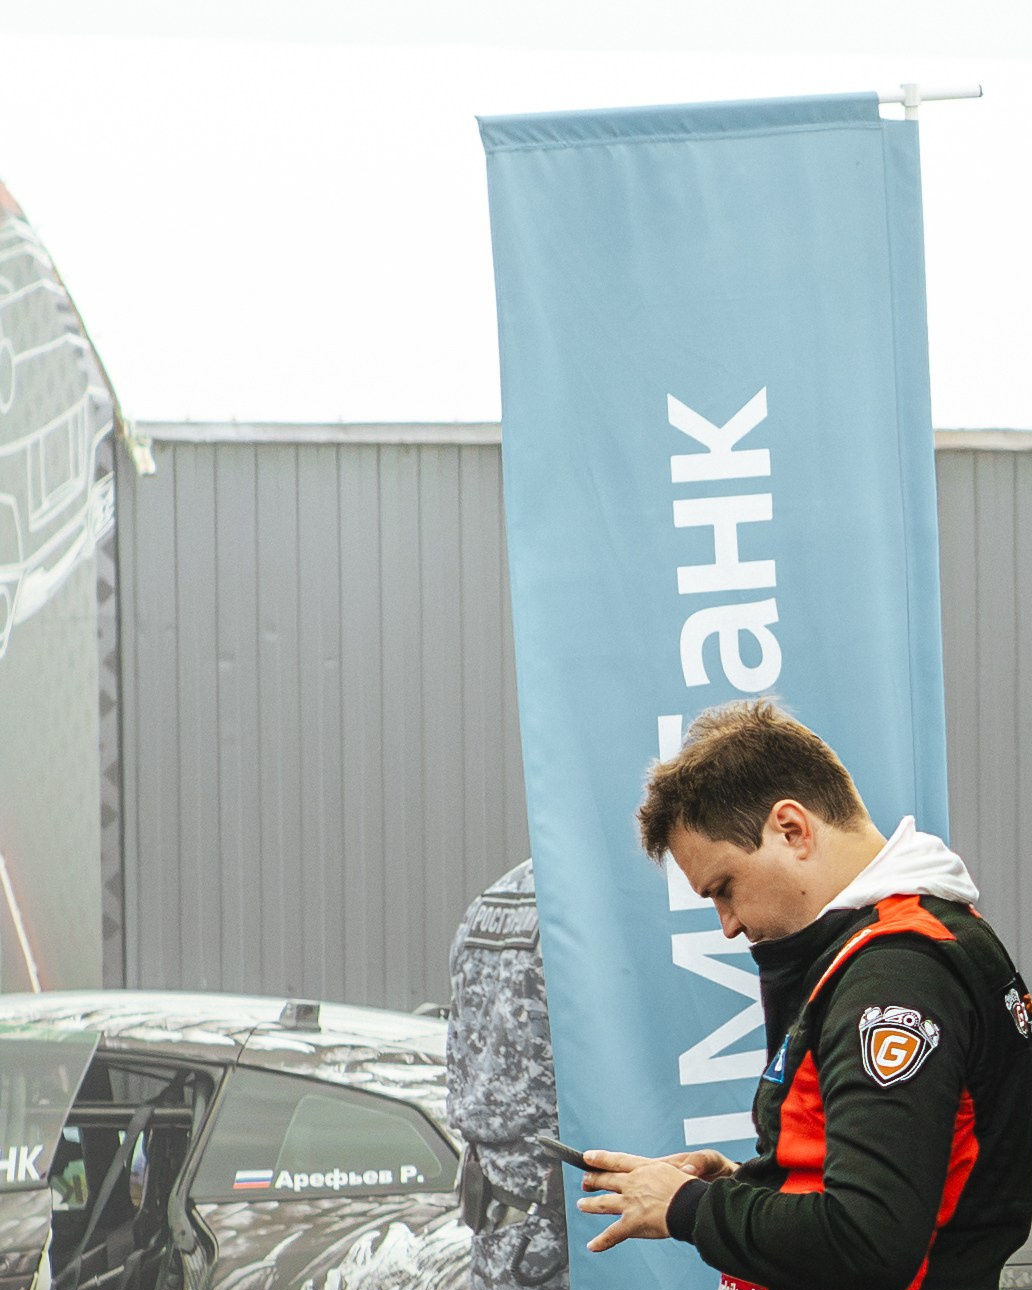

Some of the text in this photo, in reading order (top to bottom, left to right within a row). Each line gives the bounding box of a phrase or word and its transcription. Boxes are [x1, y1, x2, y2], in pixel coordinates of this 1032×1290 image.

[876, 1035, 909, 1067] G
[275, 1164, 425, 1192] Арефьев Р.
